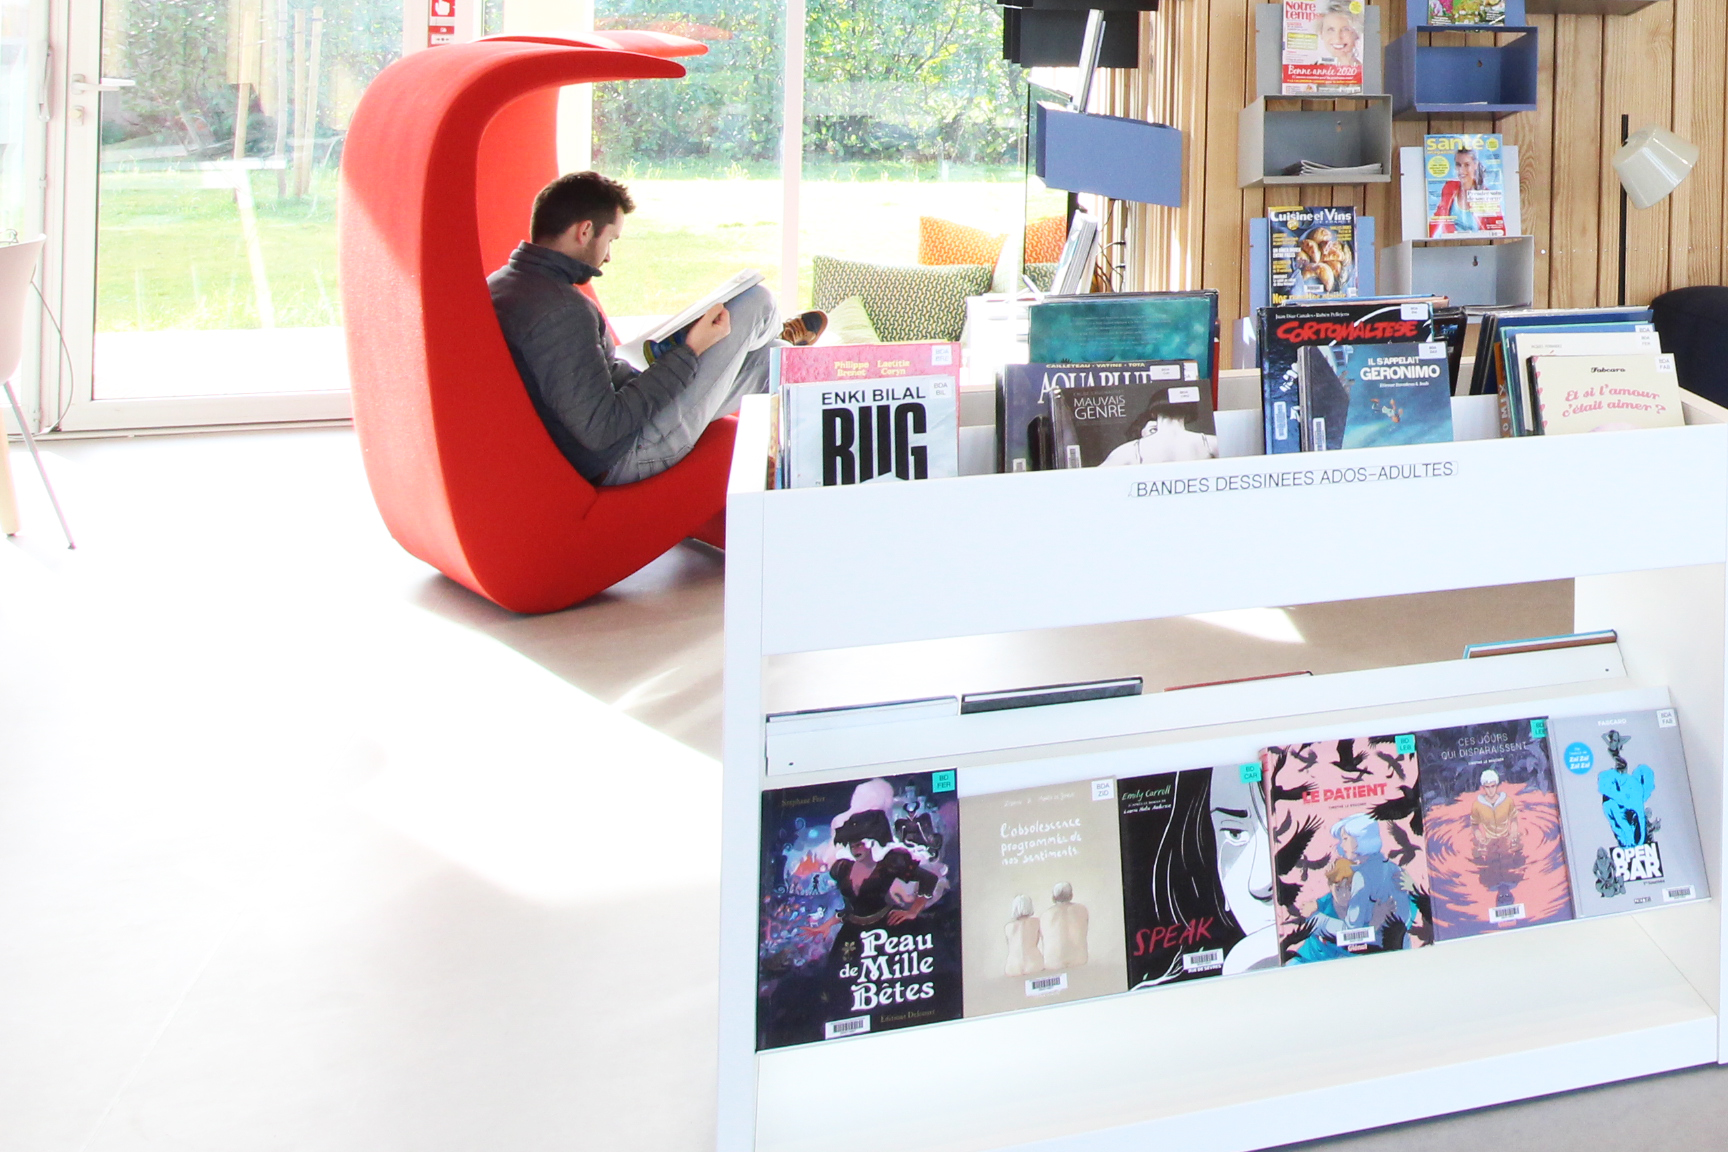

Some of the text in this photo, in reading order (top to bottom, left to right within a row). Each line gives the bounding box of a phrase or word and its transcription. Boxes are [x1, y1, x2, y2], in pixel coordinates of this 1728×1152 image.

[1286, 1, 1316, 12] Notre
[1286, 10, 1324, 22] temps
[1288, 65, 1312, 75] Bonne
[1313, 66, 1336, 75] année
[1426, 134, 1484, 150] santé
[1270, 209, 1351, 221] Cuisine et Vins
[834, 360, 869, 369] Philippe
[877, 360, 910, 368] Laetitia
[1377, 357, 1419, 365] S'APPELAIT
[1360, 365, 1440, 381] GERONIMO
[822, 386, 926, 405] ENKI BILAL
[1073, 395, 1125, 408] MAUVAIS
[1566, 384, 1660, 402] Et si l'amour
[1074, 404, 1126, 420] GENRE
[1562, 399, 1667, 418] c'était aimer ?
[1137, 461, 1454, 497] BANDES DESSINEES ADOS-ADULTES
[1441, 742, 1527, 760] QUI DISPARAISSENT
[1458, 737, 1476, 747] CES
[1122, 784, 1171, 802] Emily Carroll
[1302, 782, 1388, 805] LE PATIENT
[1000, 831, 1082, 856] programmée de
[1612, 842, 1658, 863] OPEN
[1002, 846, 1078, 866] nos sentiments
[1616, 858, 1662, 881] BAR
[860, 928, 933, 957] Peau
[1134, 916, 1214, 956] SPEAK
[839, 951, 934, 982] de Mille
[851, 982, 935, 1011] Bêtes
